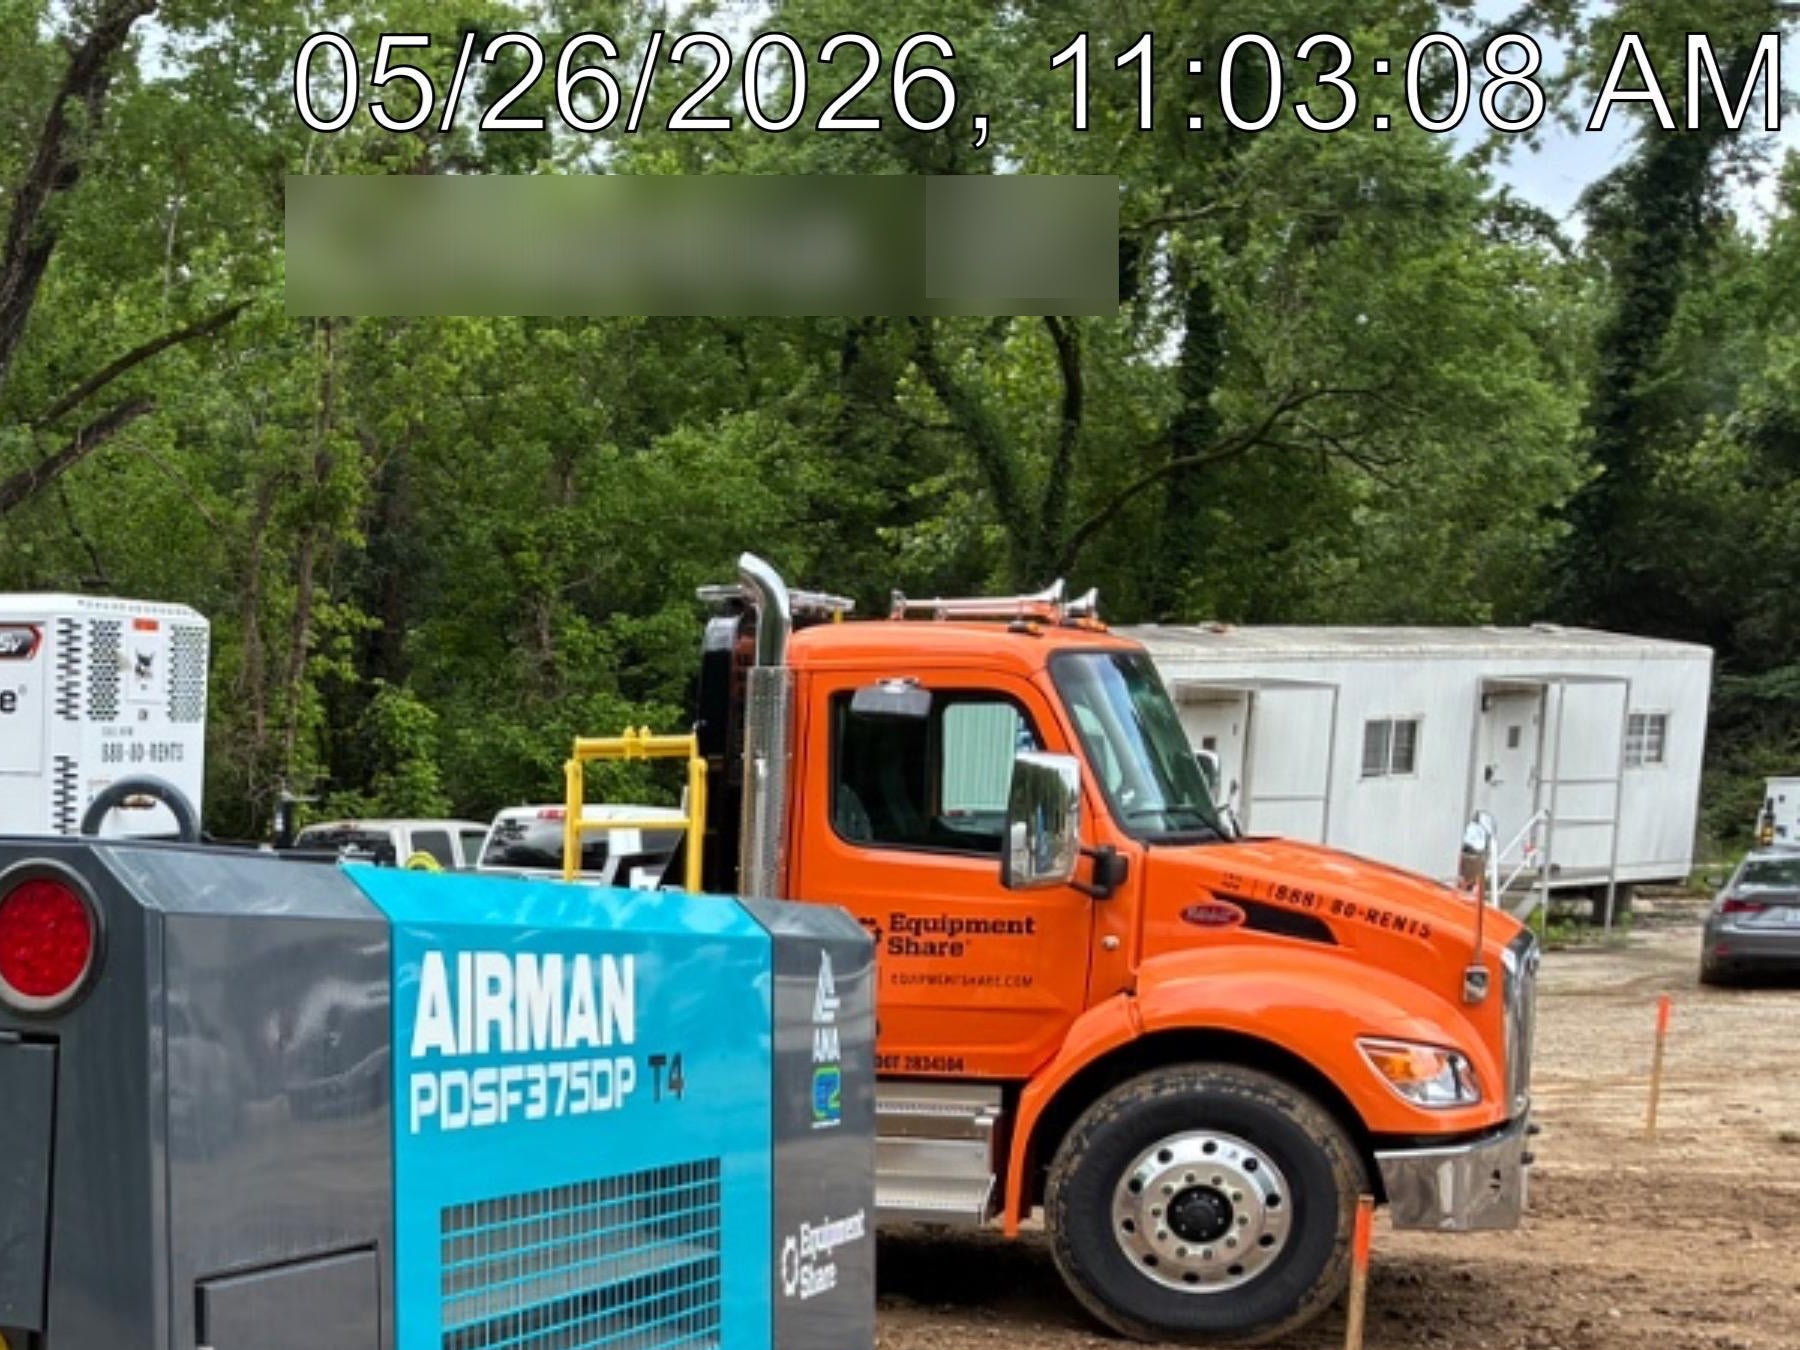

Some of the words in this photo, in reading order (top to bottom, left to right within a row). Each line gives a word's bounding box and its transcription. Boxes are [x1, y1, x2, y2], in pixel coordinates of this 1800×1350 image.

[888, 911, 1037, 936] Equipment
[1331, 897, 1433, 939] 80-RENTS
[887, 935, 965, 957] Share
[410, 950, 636, 1057] AIRMAN
[410, 1057, 637, 1135] PDSF375DP
[647, 1053, 686, 1104] T4
[800, 1208, 866, 1260] Equipment
[800, 1262, 838, 1299] Share
